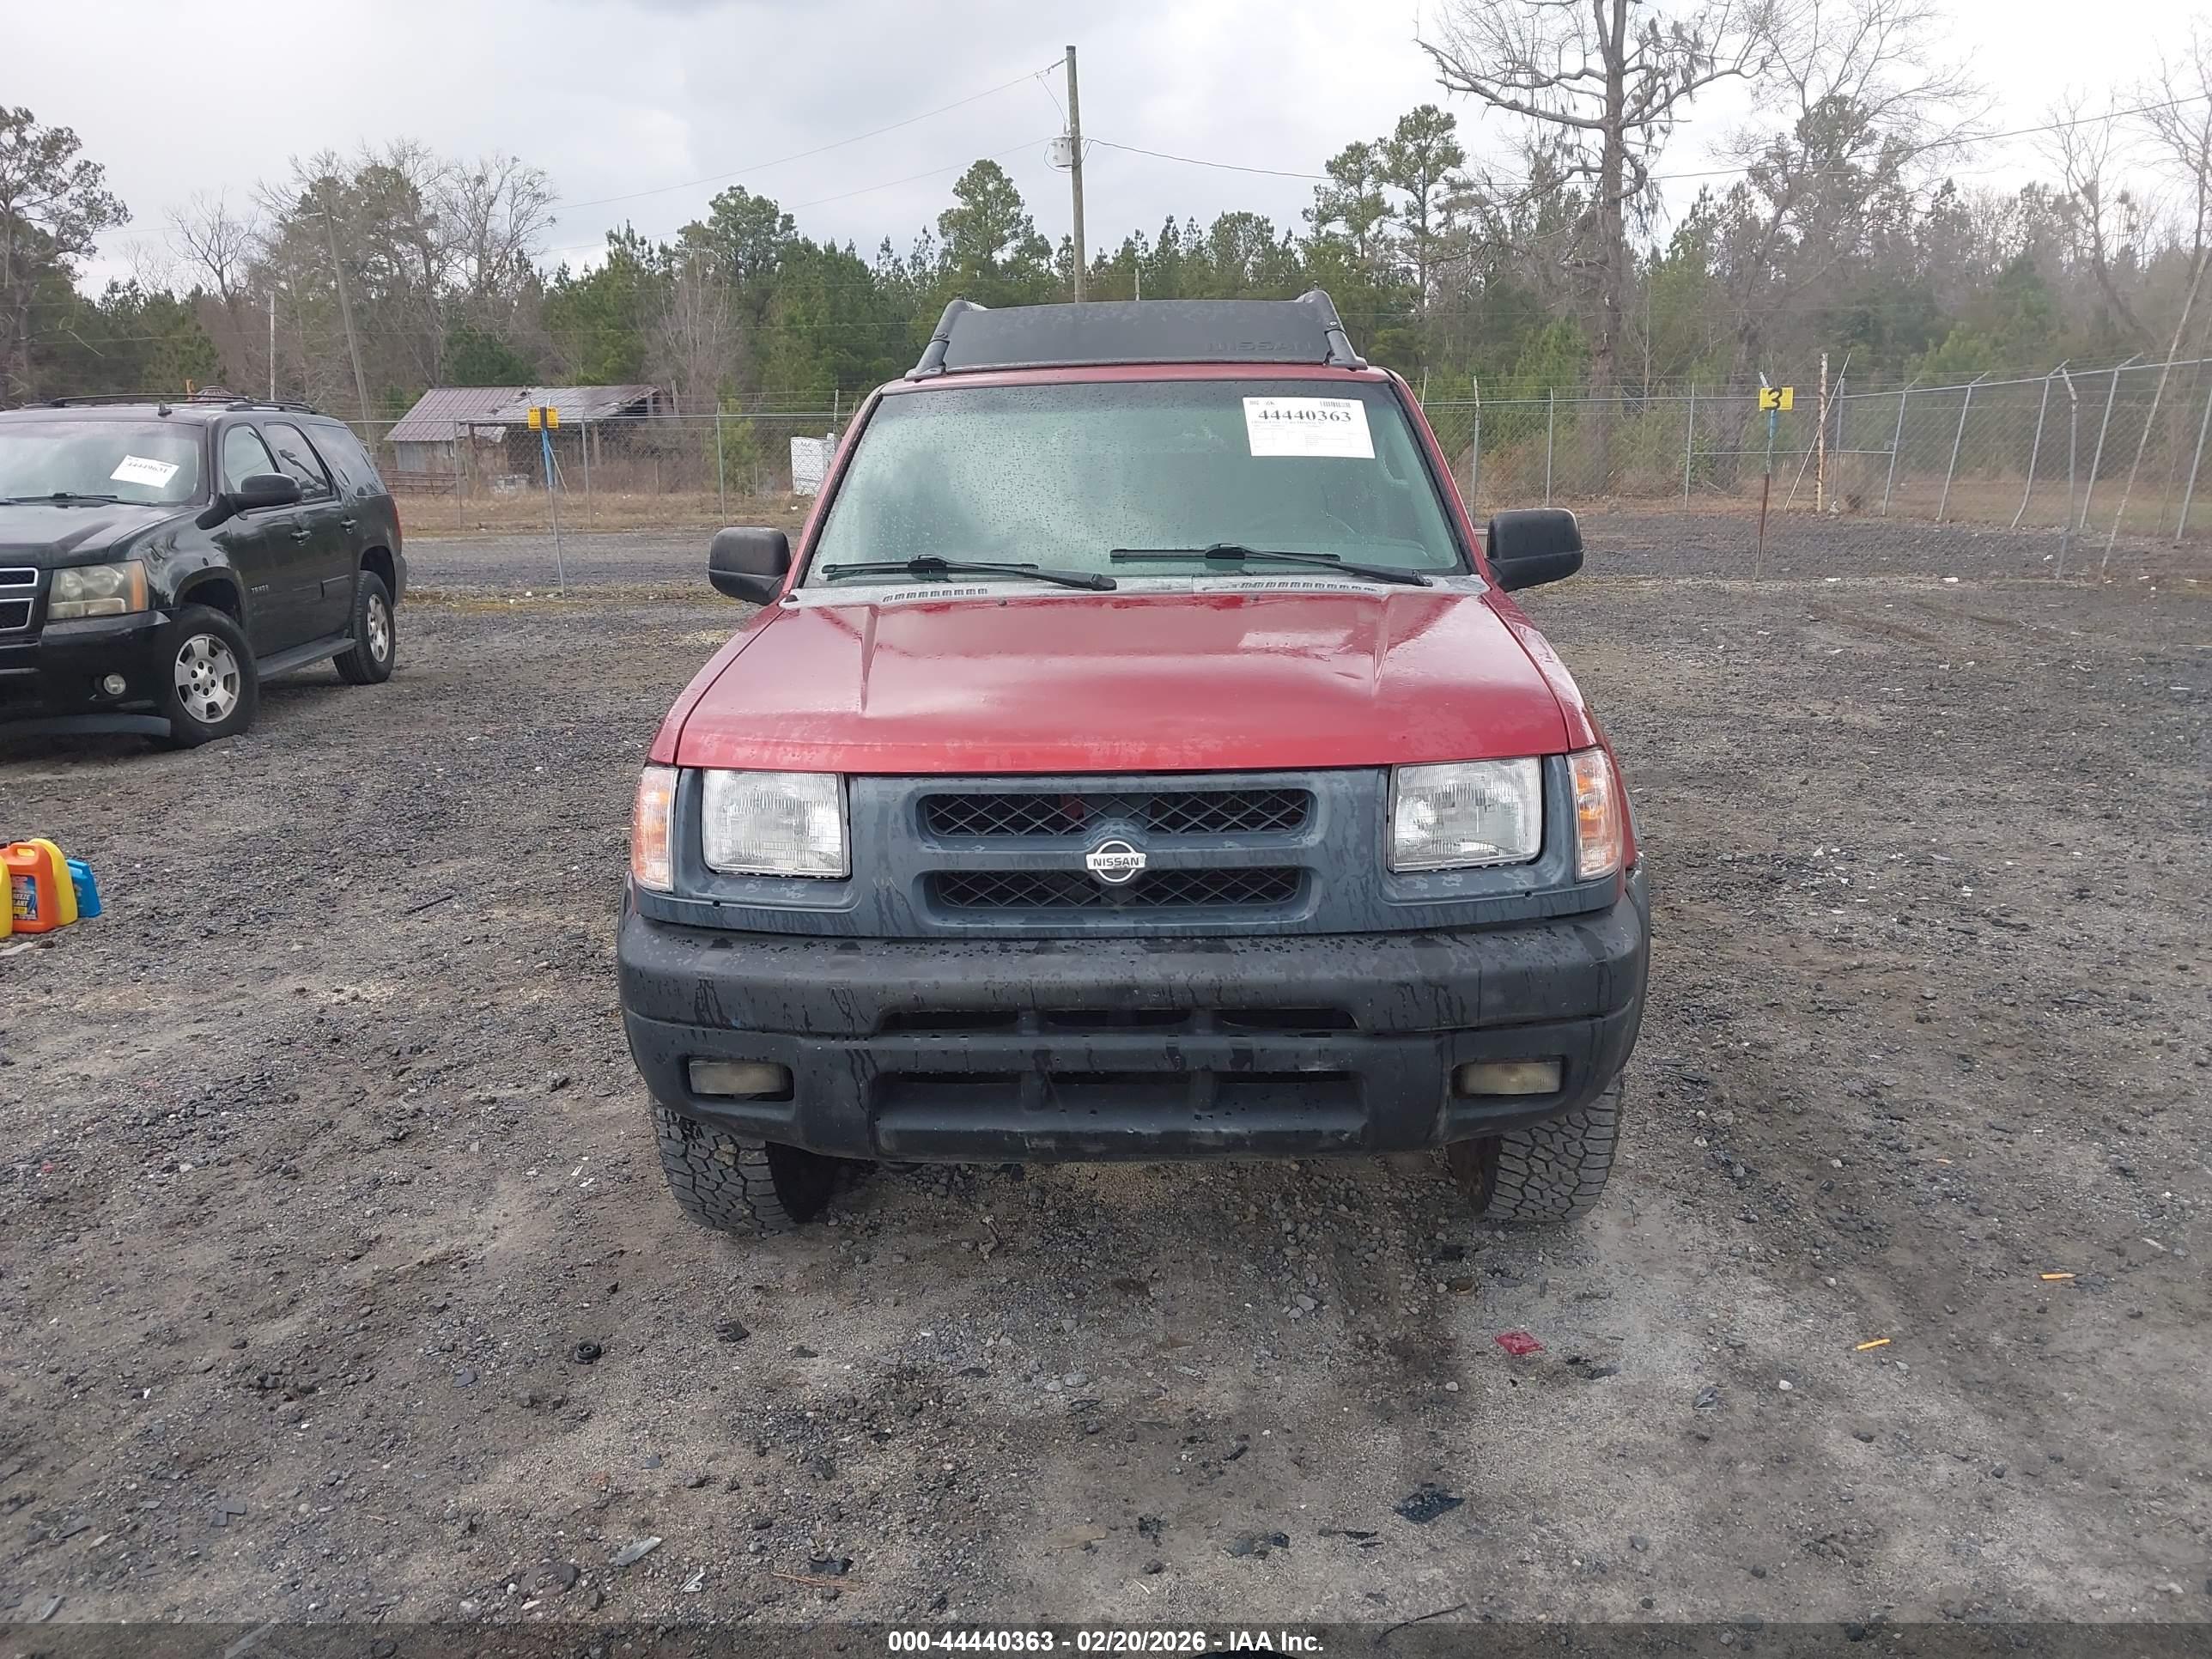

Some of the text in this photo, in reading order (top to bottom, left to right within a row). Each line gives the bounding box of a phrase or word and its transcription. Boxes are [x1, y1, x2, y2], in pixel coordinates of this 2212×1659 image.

[1765, 386, 1783, 410] 3
[1258, 410, 1352, 422] 44440363
[1093, 857, 1139, 866] NISSAN
